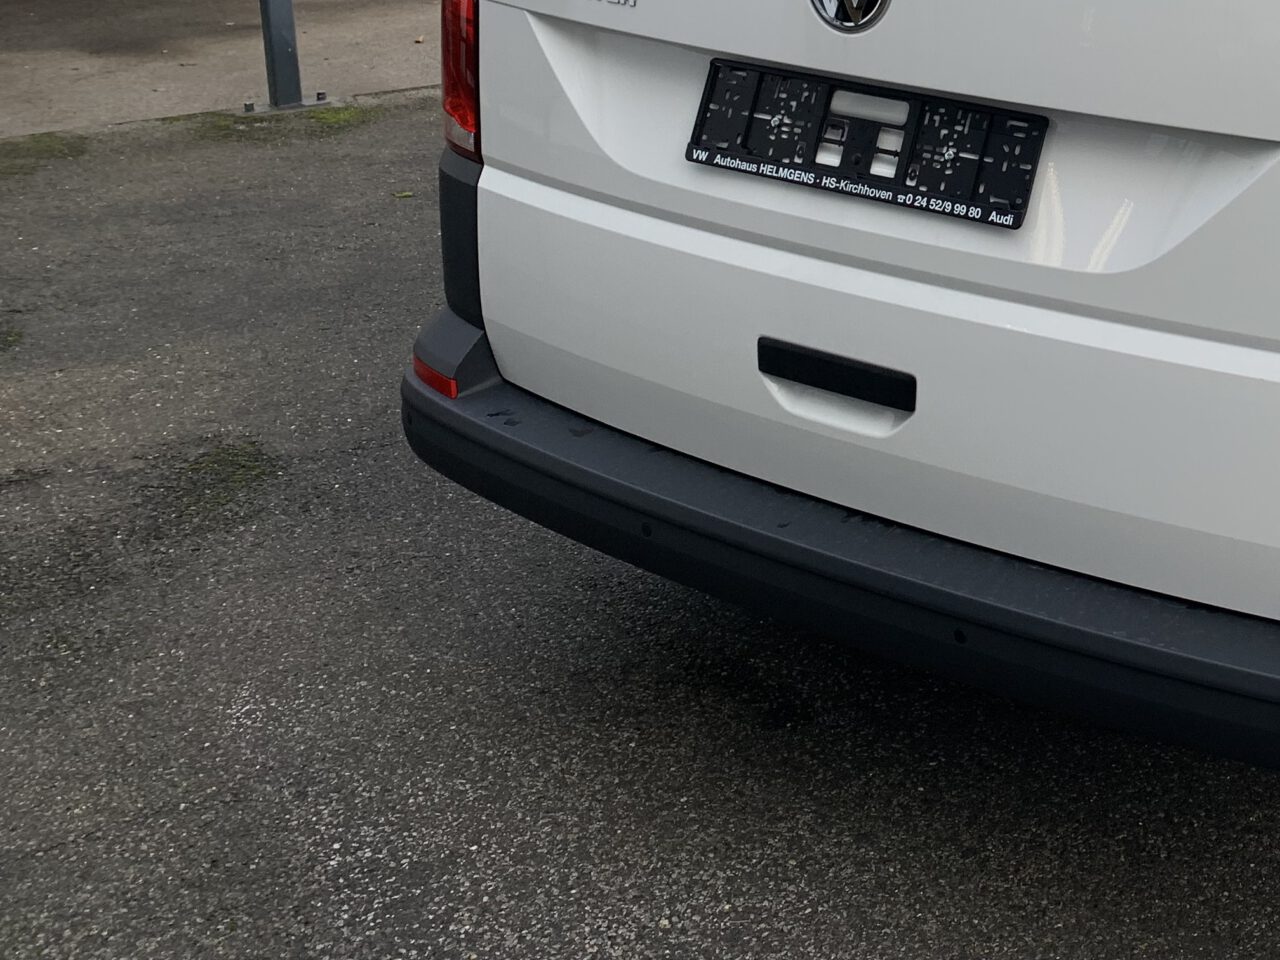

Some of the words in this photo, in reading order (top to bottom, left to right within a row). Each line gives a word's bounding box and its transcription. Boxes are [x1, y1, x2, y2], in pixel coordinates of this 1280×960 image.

[692, 148, 709, 161] VW
[713, 154, 758, 173] Autohaus
[759, 163, 815, 185] HELMGENS
[821, 176, 893, 201] HS-Kirchhoven
[913, 195, 927, 208] 24
[928, 198, 952, 213] 52/9
[953, 203, 967, 216] 99
[968, 206, 982, 219] 80
[988, 211, 1015, 226] Audi
